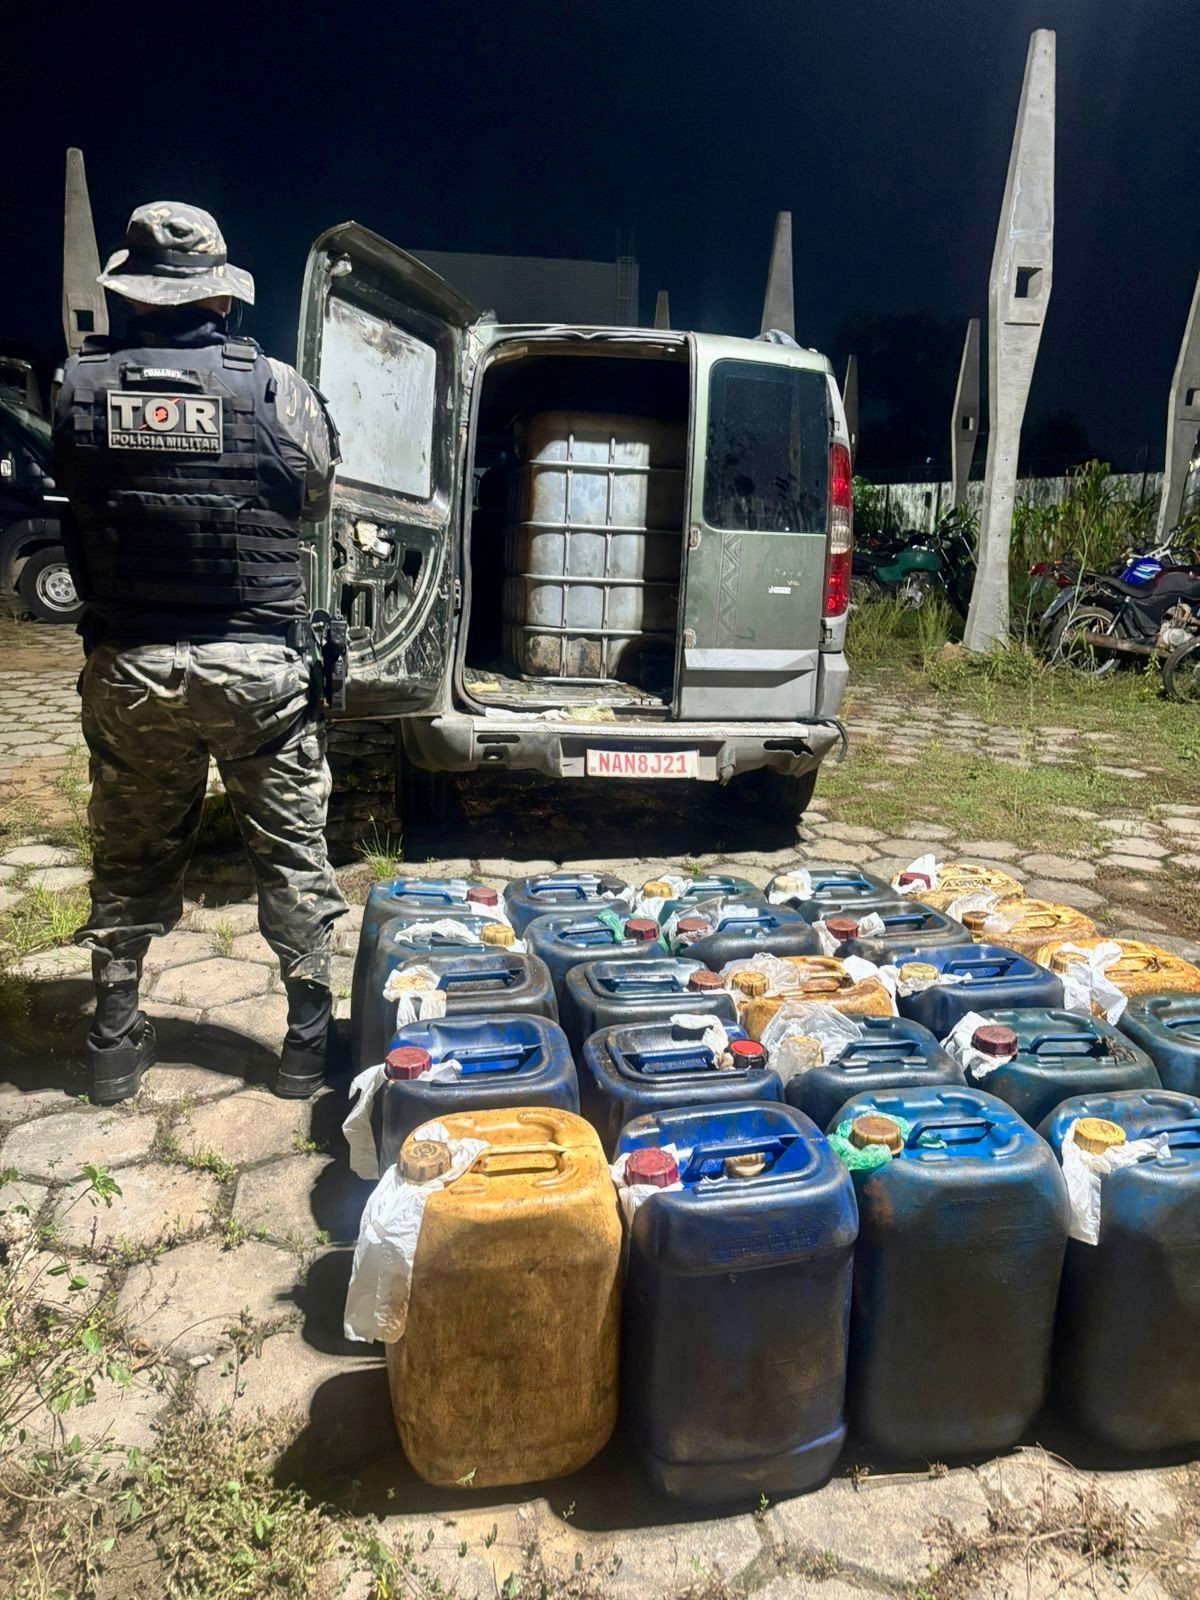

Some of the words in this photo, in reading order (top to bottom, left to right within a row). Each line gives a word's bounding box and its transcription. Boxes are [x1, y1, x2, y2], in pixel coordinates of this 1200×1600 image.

[111, 396, 218, 433] TOR
[112, 434, 164, 447] POLÍCIA
[166, 437, 219, 449] MILITAR
[599, 753, 687, 774] NAN8J21
